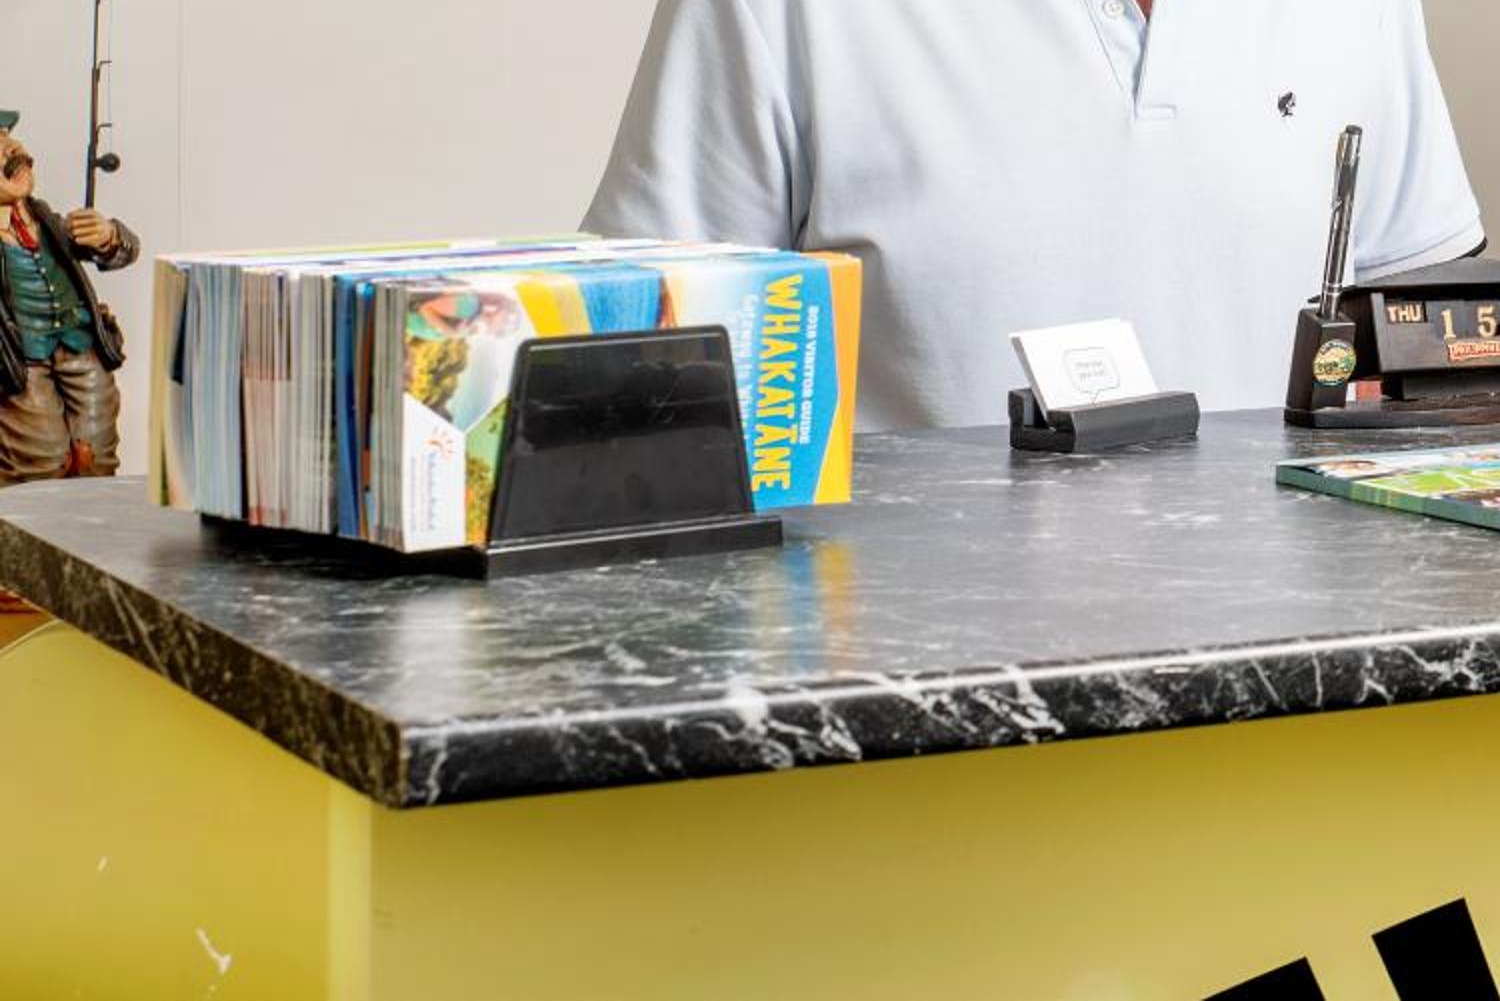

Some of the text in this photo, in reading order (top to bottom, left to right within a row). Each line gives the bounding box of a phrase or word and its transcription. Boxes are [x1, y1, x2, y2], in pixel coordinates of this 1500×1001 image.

[1387, 303, 1422, 323] THU
[801, 341, 816, 399] VISITOR
[798, 401, 814, 445] GUIDE
